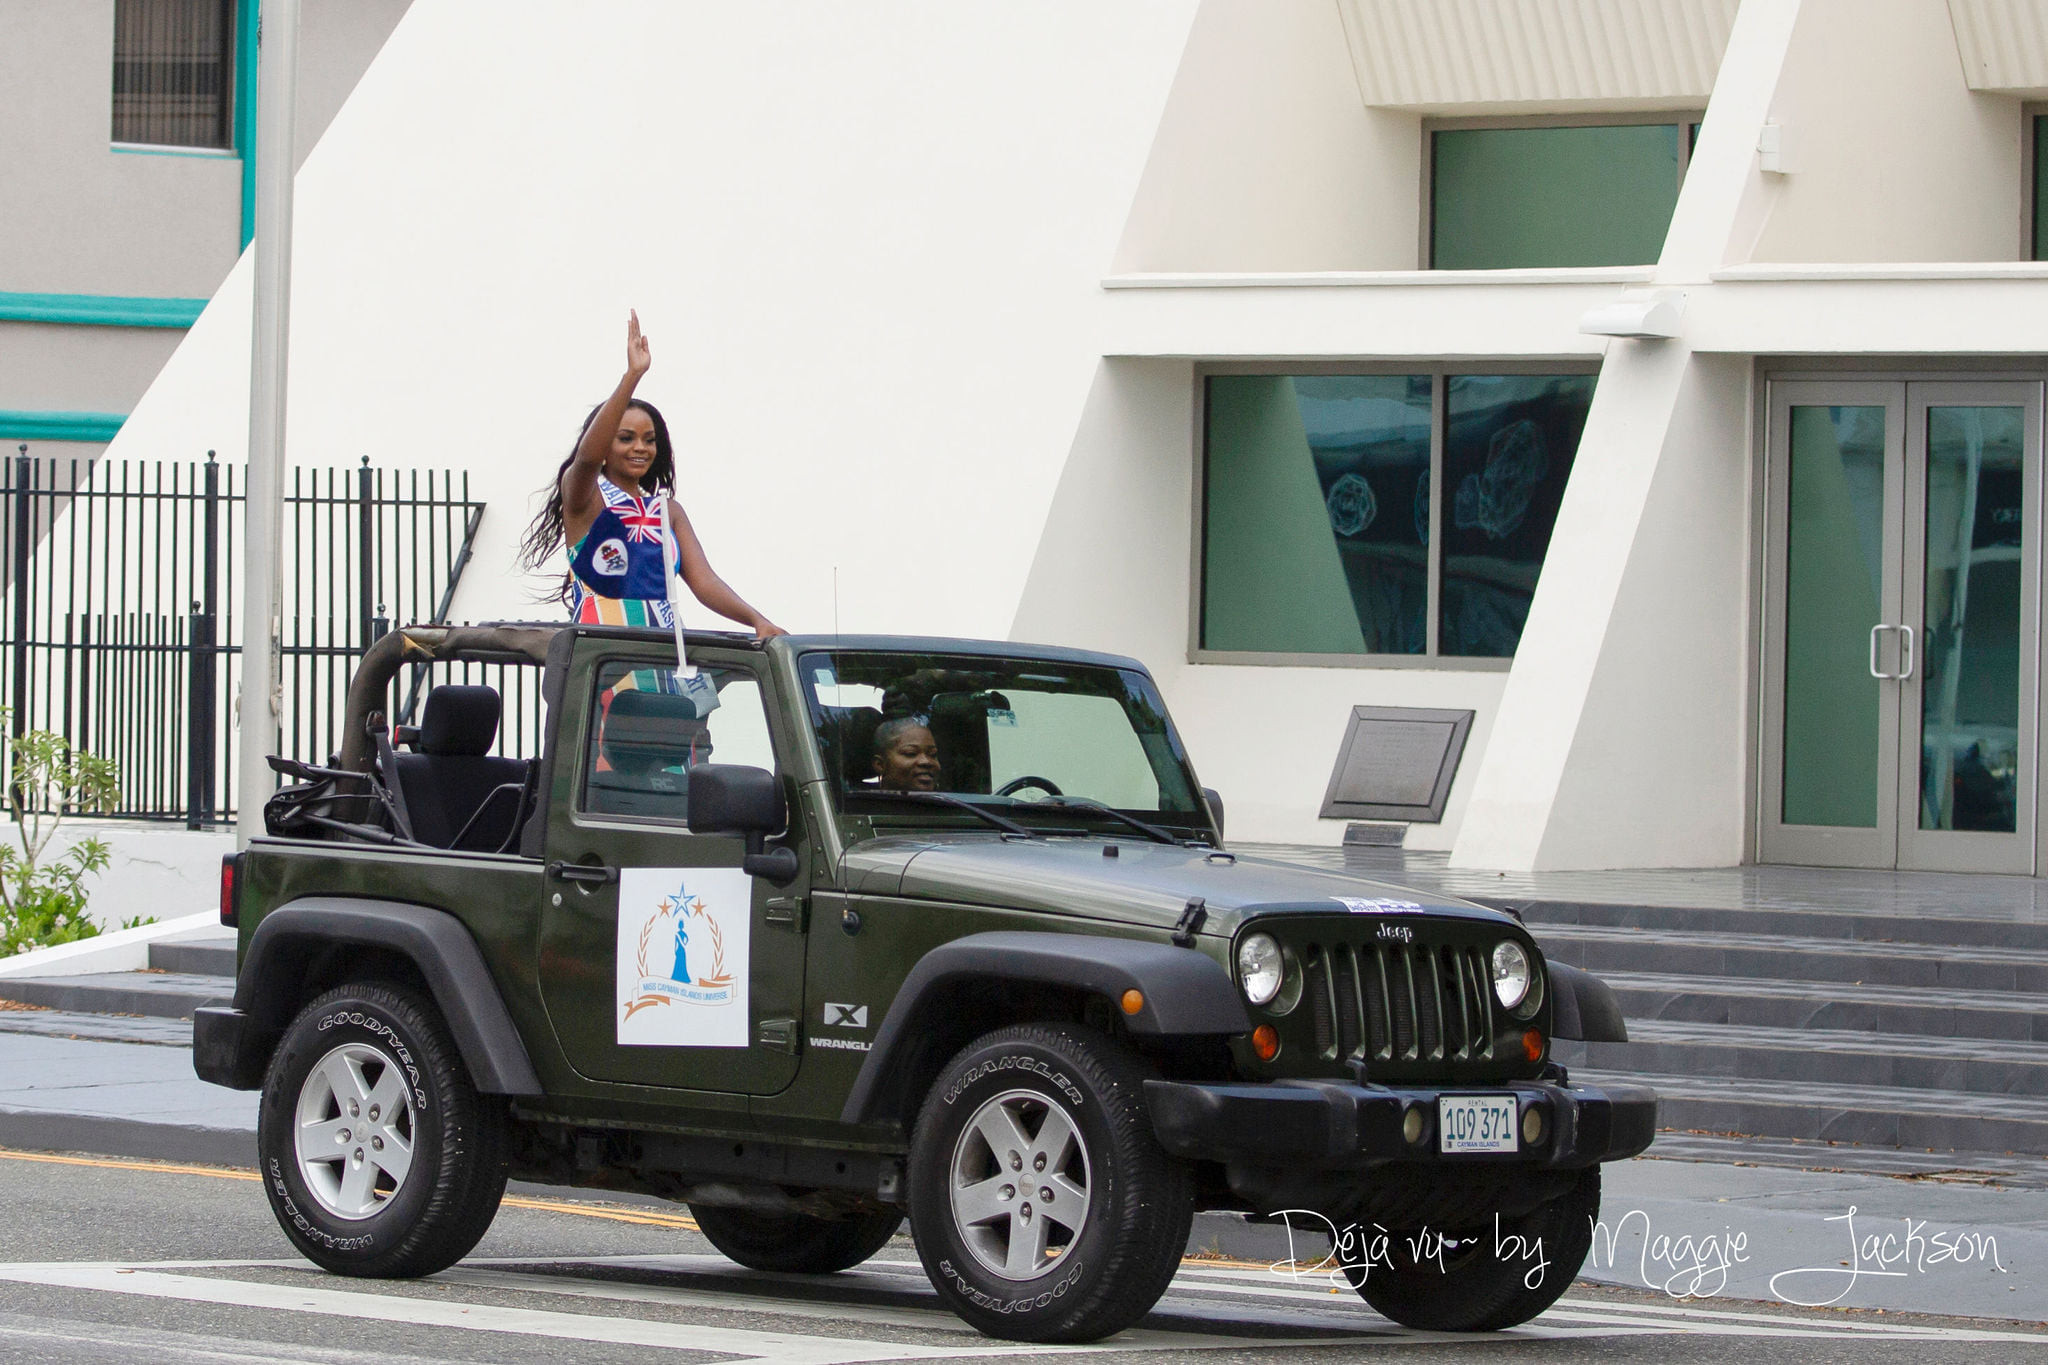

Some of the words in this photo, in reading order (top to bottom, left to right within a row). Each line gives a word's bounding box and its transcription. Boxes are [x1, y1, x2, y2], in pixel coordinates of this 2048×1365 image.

[685, 673, 708, 694] RT
[1376, 922, 1413, 943] Jeep
[642, 982, 657, 992] MISS
[657, 983, 680, 995] CAYMAN
[680, 988, 703, 1001] ISLANDS
[703, 990, 728, 1001] UNIVERSE
[828, 1003, 866, 1028] X
[809, 1037, 874, 1051] WRANGL
[318, 1011, 427, 1110] GOODYEAR
[943, 1056, 1083, 1105] WRANGLER
[1446, 1107, 1476, 1140] 109
[1480, 1107, 1511, 1140] 371
[270, 1157, 373, 1250] WRANGLER
[939, 1259, 1083, 1314] GOODYEAR
